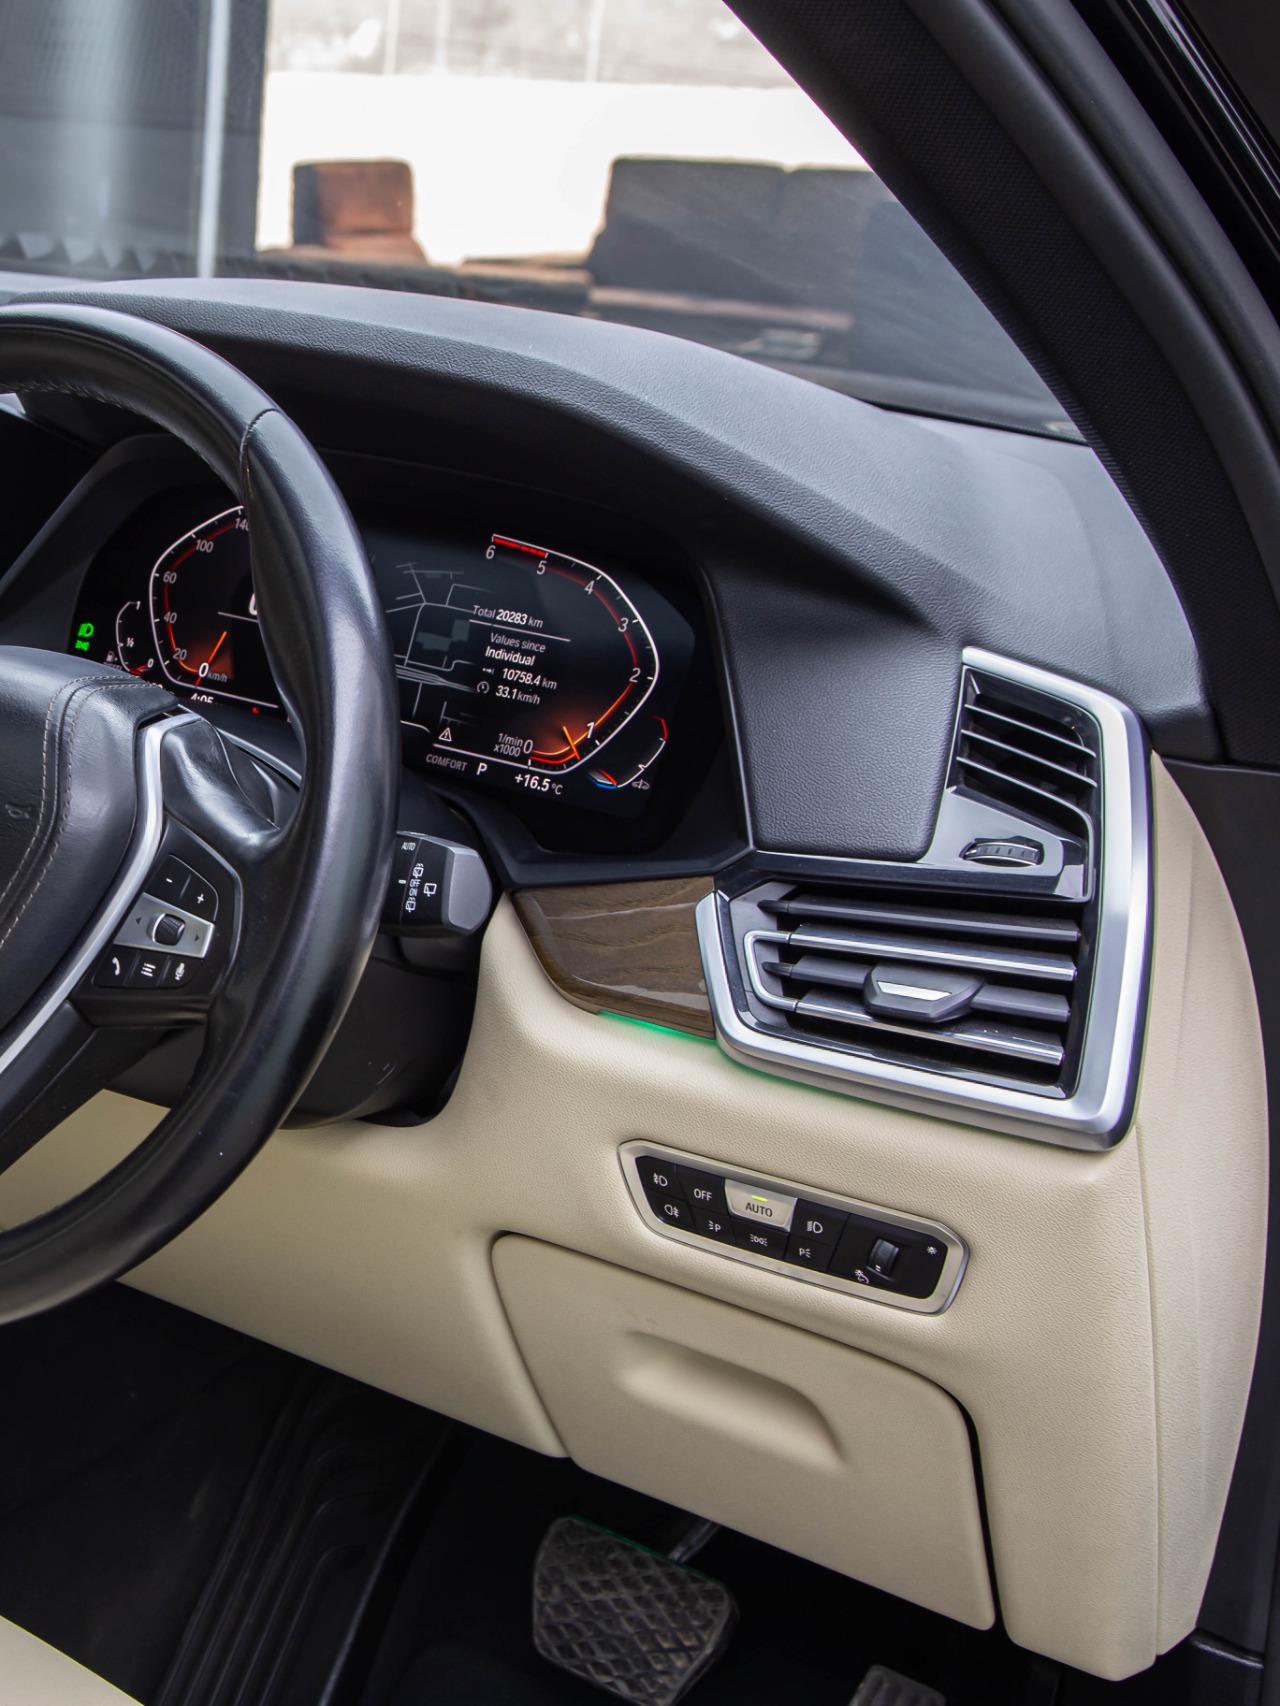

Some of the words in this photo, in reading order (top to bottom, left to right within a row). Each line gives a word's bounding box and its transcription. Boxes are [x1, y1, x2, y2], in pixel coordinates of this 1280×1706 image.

[196, 539, 214, 553] 100
[485, 544, 496, 559] 6
[536, 561, 547, 575] 5
[163, 571, 177, 584] 60
[584, 580, 595, 595] 4
[163, 611, 177, 624] 40
[473, 604, 496, 619] Total
[496, 609, 528, 625] 20283
[528, 616, 544, 629] km
[617, 618, 628, 632] 3
[491, 632, 520, 648] Values
[521, 640, 546, 653] since
[173, 648, 187, 660] 20
[485, 645, 536, 666] Individual
[147, 658, 154, 668] 0
[198, 662, 209, 678] 0
[207, 671, 228, 683] km/h
[503, 668, 541, 687] 10758.4
[542, 678, 557, 690] km
[629, 668, 641, 683] 2
[586, 722, 596, 739] 1
[493, 743, 521, 757] x1000
[498, 733, 523, 747] 1/min
[523, 740, 534, 754] 0
[426, 754, 468, 772] COMFORT
[476, 763, 488, 775] P
[514, 773, 551, 792] +16.5
[401, 842, 416, 851] AUTO
[409, 879, 421, 887] OFF
[693, 1188, 713, 1201] OFF
[745, 1202, 773, 1218] AUTO
